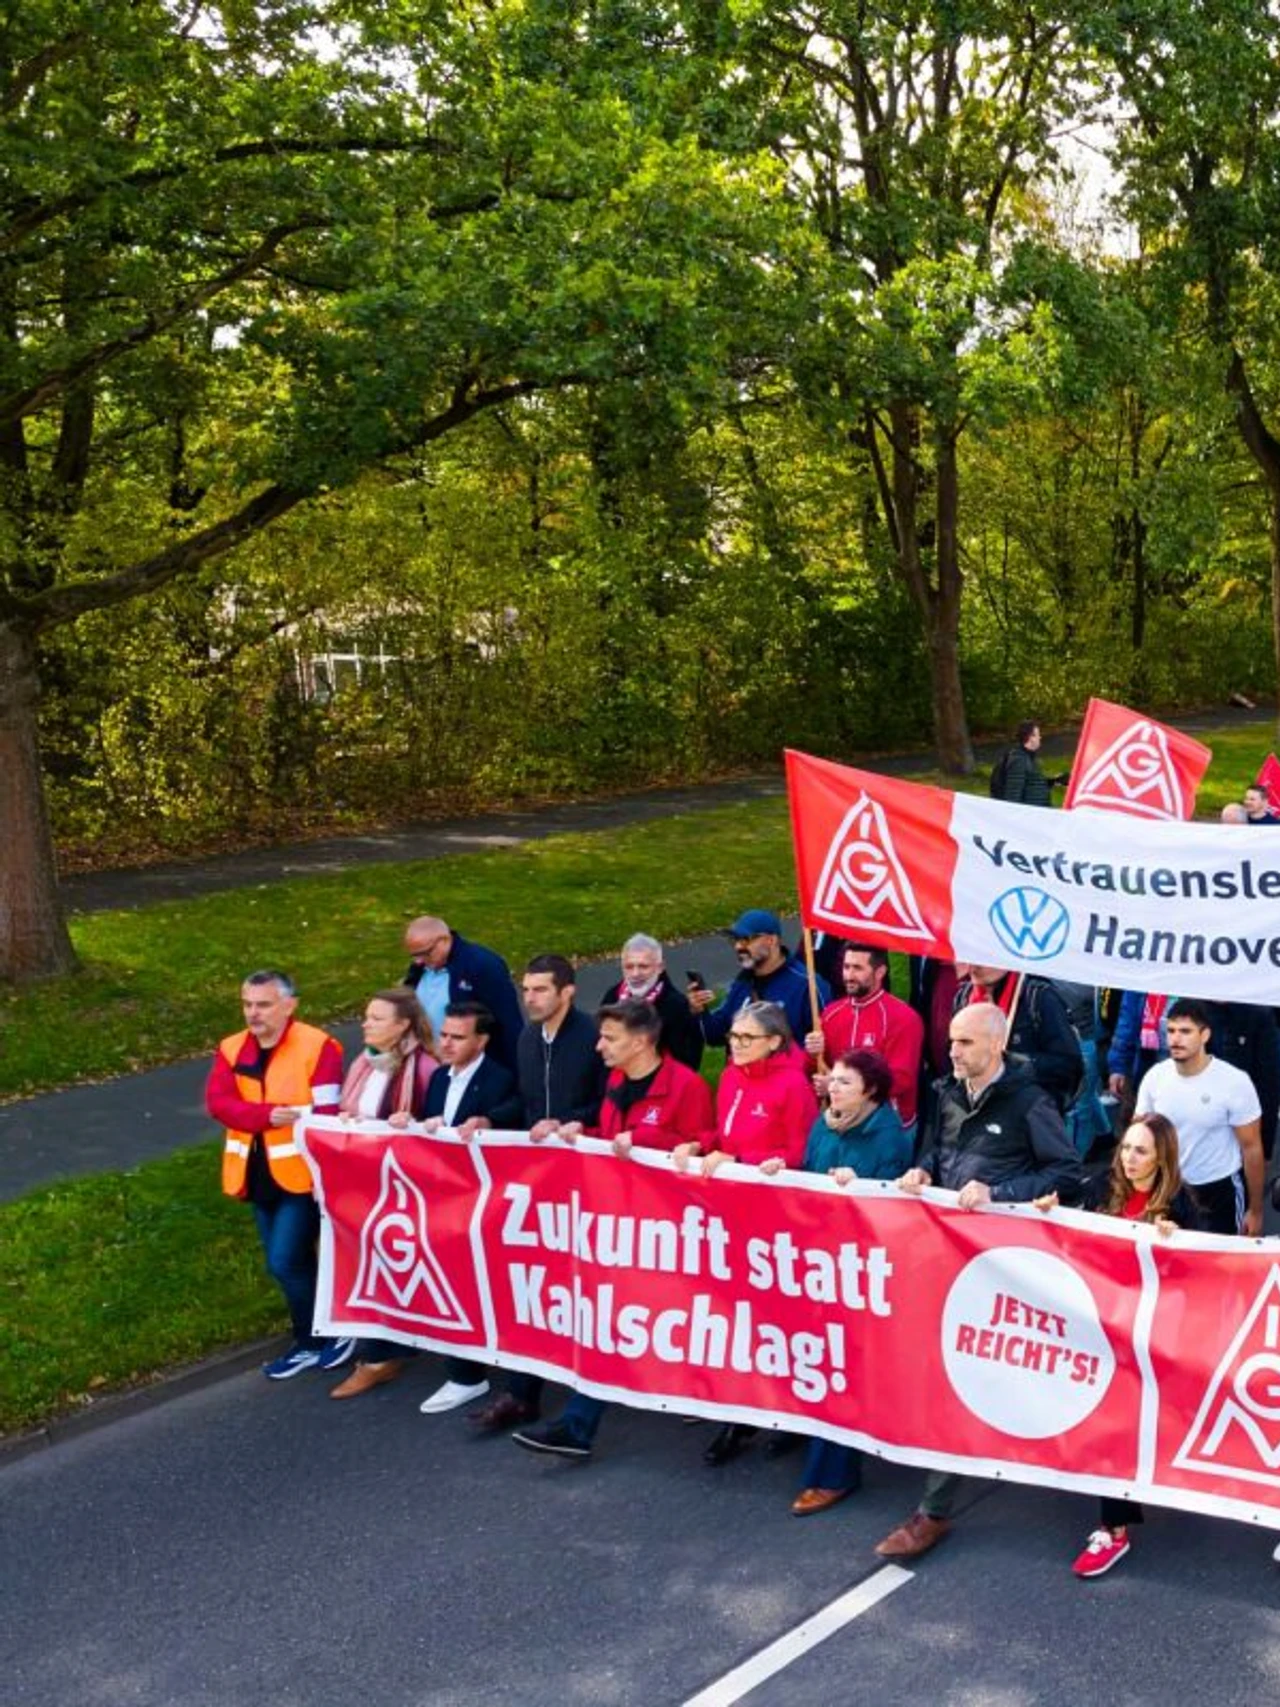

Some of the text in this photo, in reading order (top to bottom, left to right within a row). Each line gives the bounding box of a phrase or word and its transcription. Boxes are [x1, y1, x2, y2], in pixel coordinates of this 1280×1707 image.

[824, 812, 916, 927] IGM
[993, 887, 1067, 953] VW
[366, 1178, 454, 1318] IGM
[502, 1182, 893, 1317] Zukunft statt
[508, 1261, 848, 1403] Kahlschlag!
[991, 1292, 1068, 1338] JETZT
